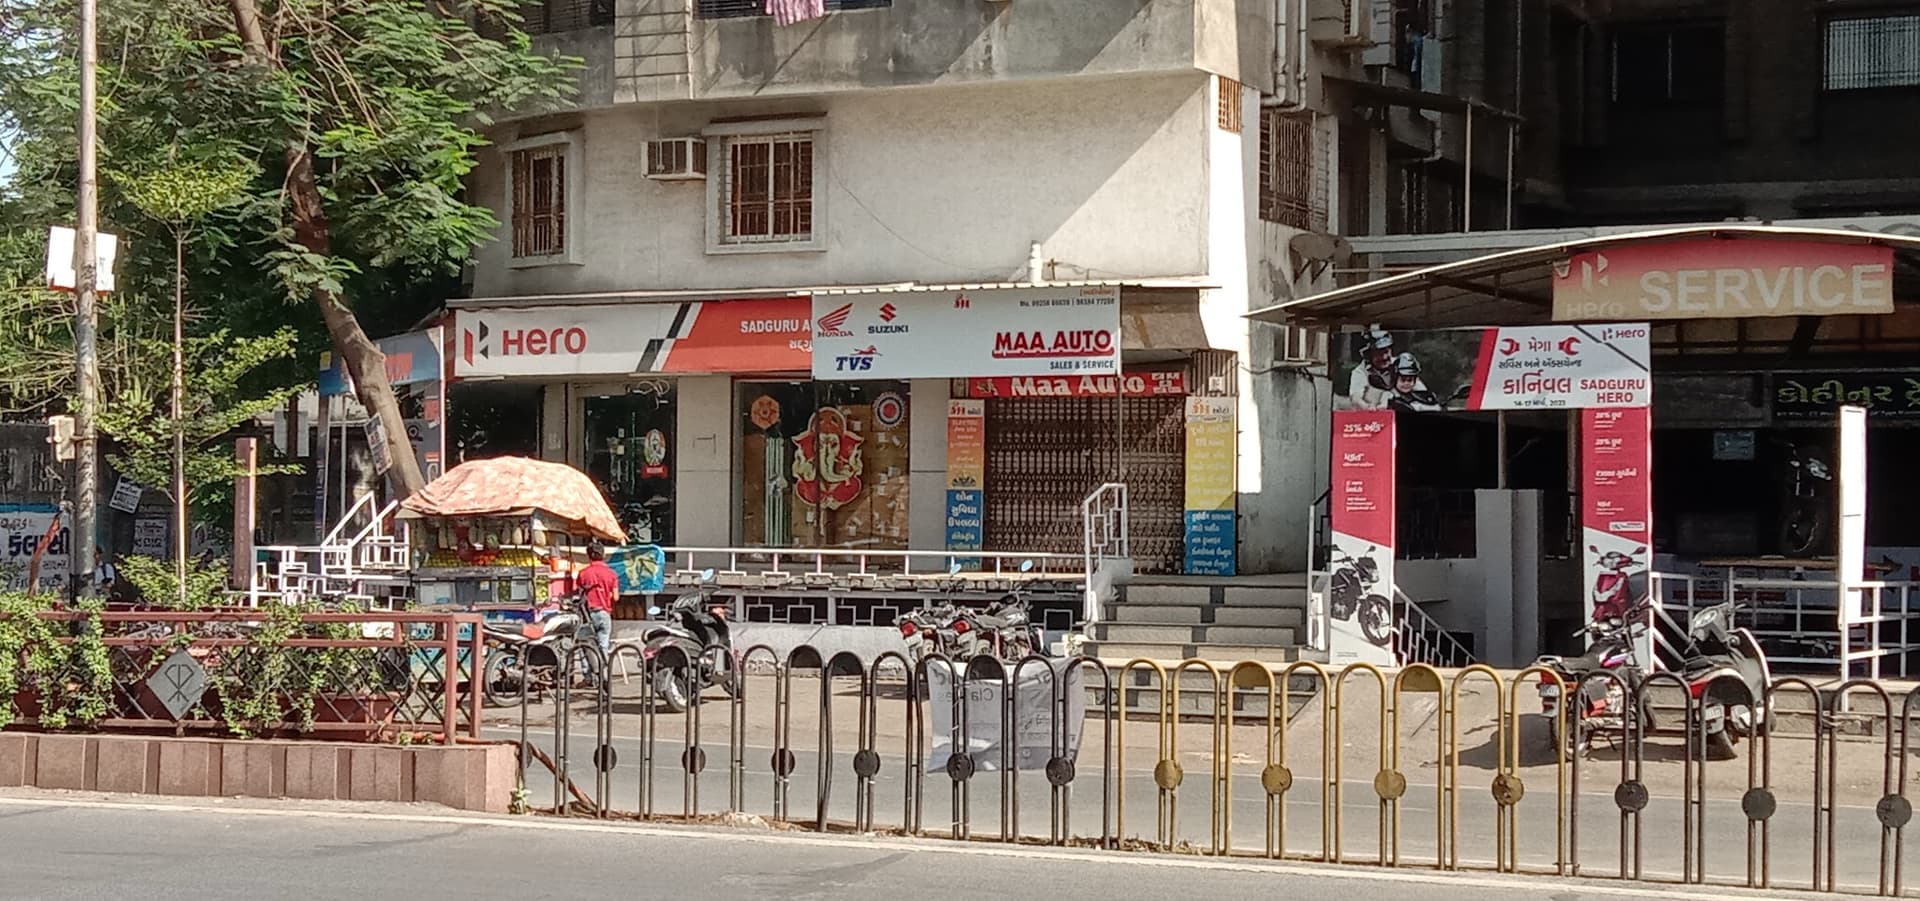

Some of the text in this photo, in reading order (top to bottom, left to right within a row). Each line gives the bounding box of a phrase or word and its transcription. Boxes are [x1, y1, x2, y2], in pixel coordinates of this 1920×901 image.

[1639, 263, 1886, 313] SERVICE
[740, 319, 799, 334] SADGURU
[868, 325, 909, 334] SUZUKI
[817, 330, 854, 338] HONDA
[1615, 328, 1646, 339] Hero
[502, 327, 587, 356] Hero
[1528, 336, 1551, 352] મેગા
[836, 356, 873, 371] TVS
[1050, 361, 1073, 370] SALES
[1083, 360, 1114, 369] SERVICE
[1498, 359, 1523, 369] સર્વિસ
[1524, 358, 1541, 368] અને
[1011, 374, 1145, 397] Maa Auto
[1502, 369, 1572, 395] કાર્નિવલ
[1580, 379, 1645, 391] SADGURU
[1596, 392, 1634, 404] HERO
